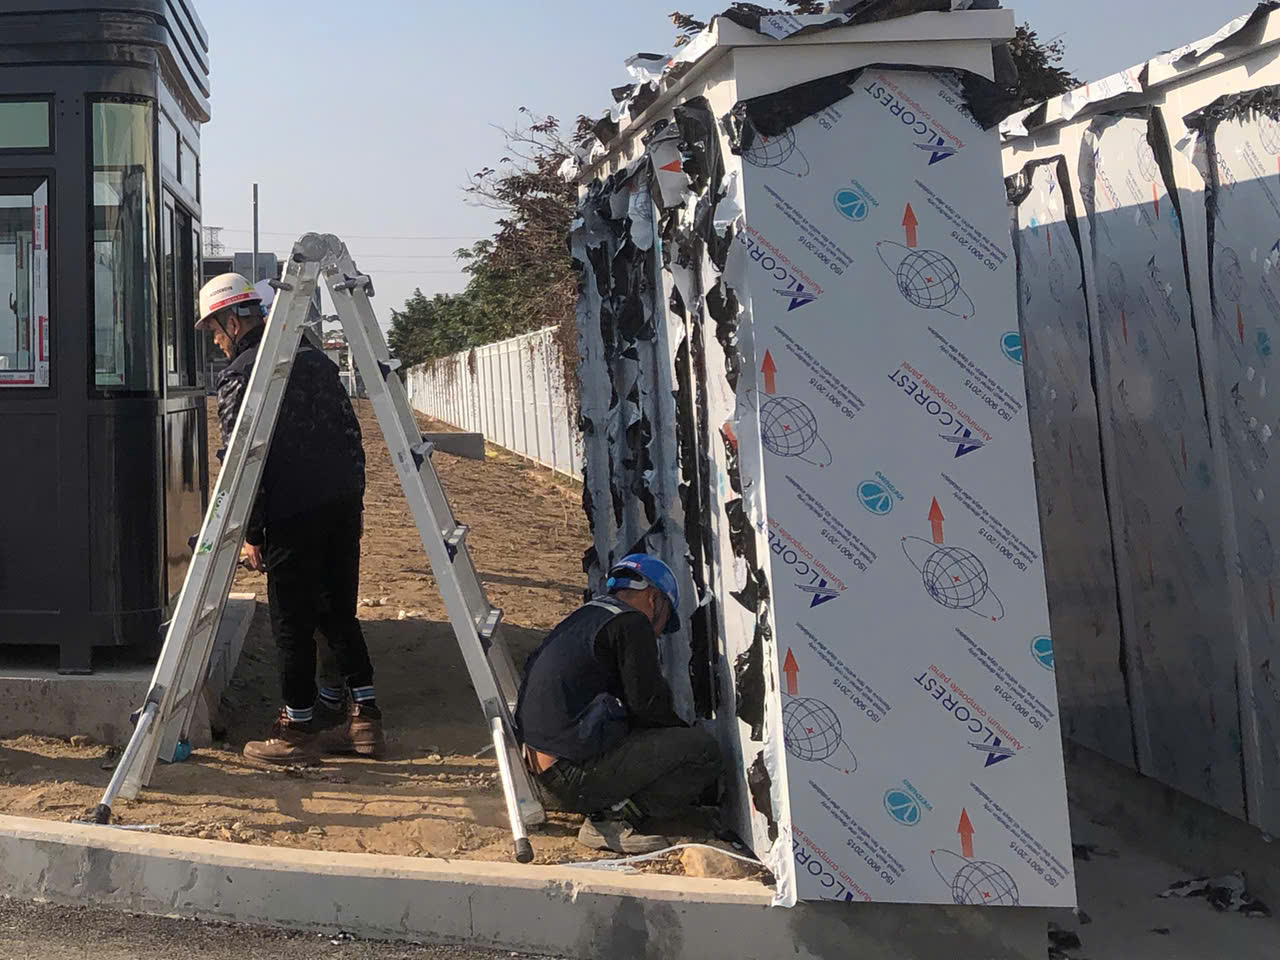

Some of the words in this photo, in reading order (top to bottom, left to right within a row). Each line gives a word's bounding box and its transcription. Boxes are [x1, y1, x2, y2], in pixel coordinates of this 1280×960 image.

[819, 116, 833, 130] ISO
[864, 82, 958, 165] ALCOREST
[930, 118, 965, 149] Aluminum
[830, 262, 844, 276] ISO
[983, 257, 998, 272] ISO
[899, 359, 923, 381] panel
[920, 376, 958, 412] composite
[841, 405, 855, 419] ISO
[887, 369, 985, 458] ALCOREST
[997, 407, 1012, 422] ISO
[956, 408, 992, 442] Aluminum
[853, 557, 868, 572] ISO
[1012, 557, 1028, 572] ISO
[811, 558, 848, 593] Aluminum
[927, 661, 951, 684] panel
[948, 680, 988, 718] composite
[866, 708, 881, 724] ISO
[913, 671, 1015, 767] ALCOREST
[1028, 715, 1044, 731] ISO
[985, 715, 1023, 752] Aluminum
[880, 870, 895, 886] ISO
[1044, 873, 1059, 888] ISO
